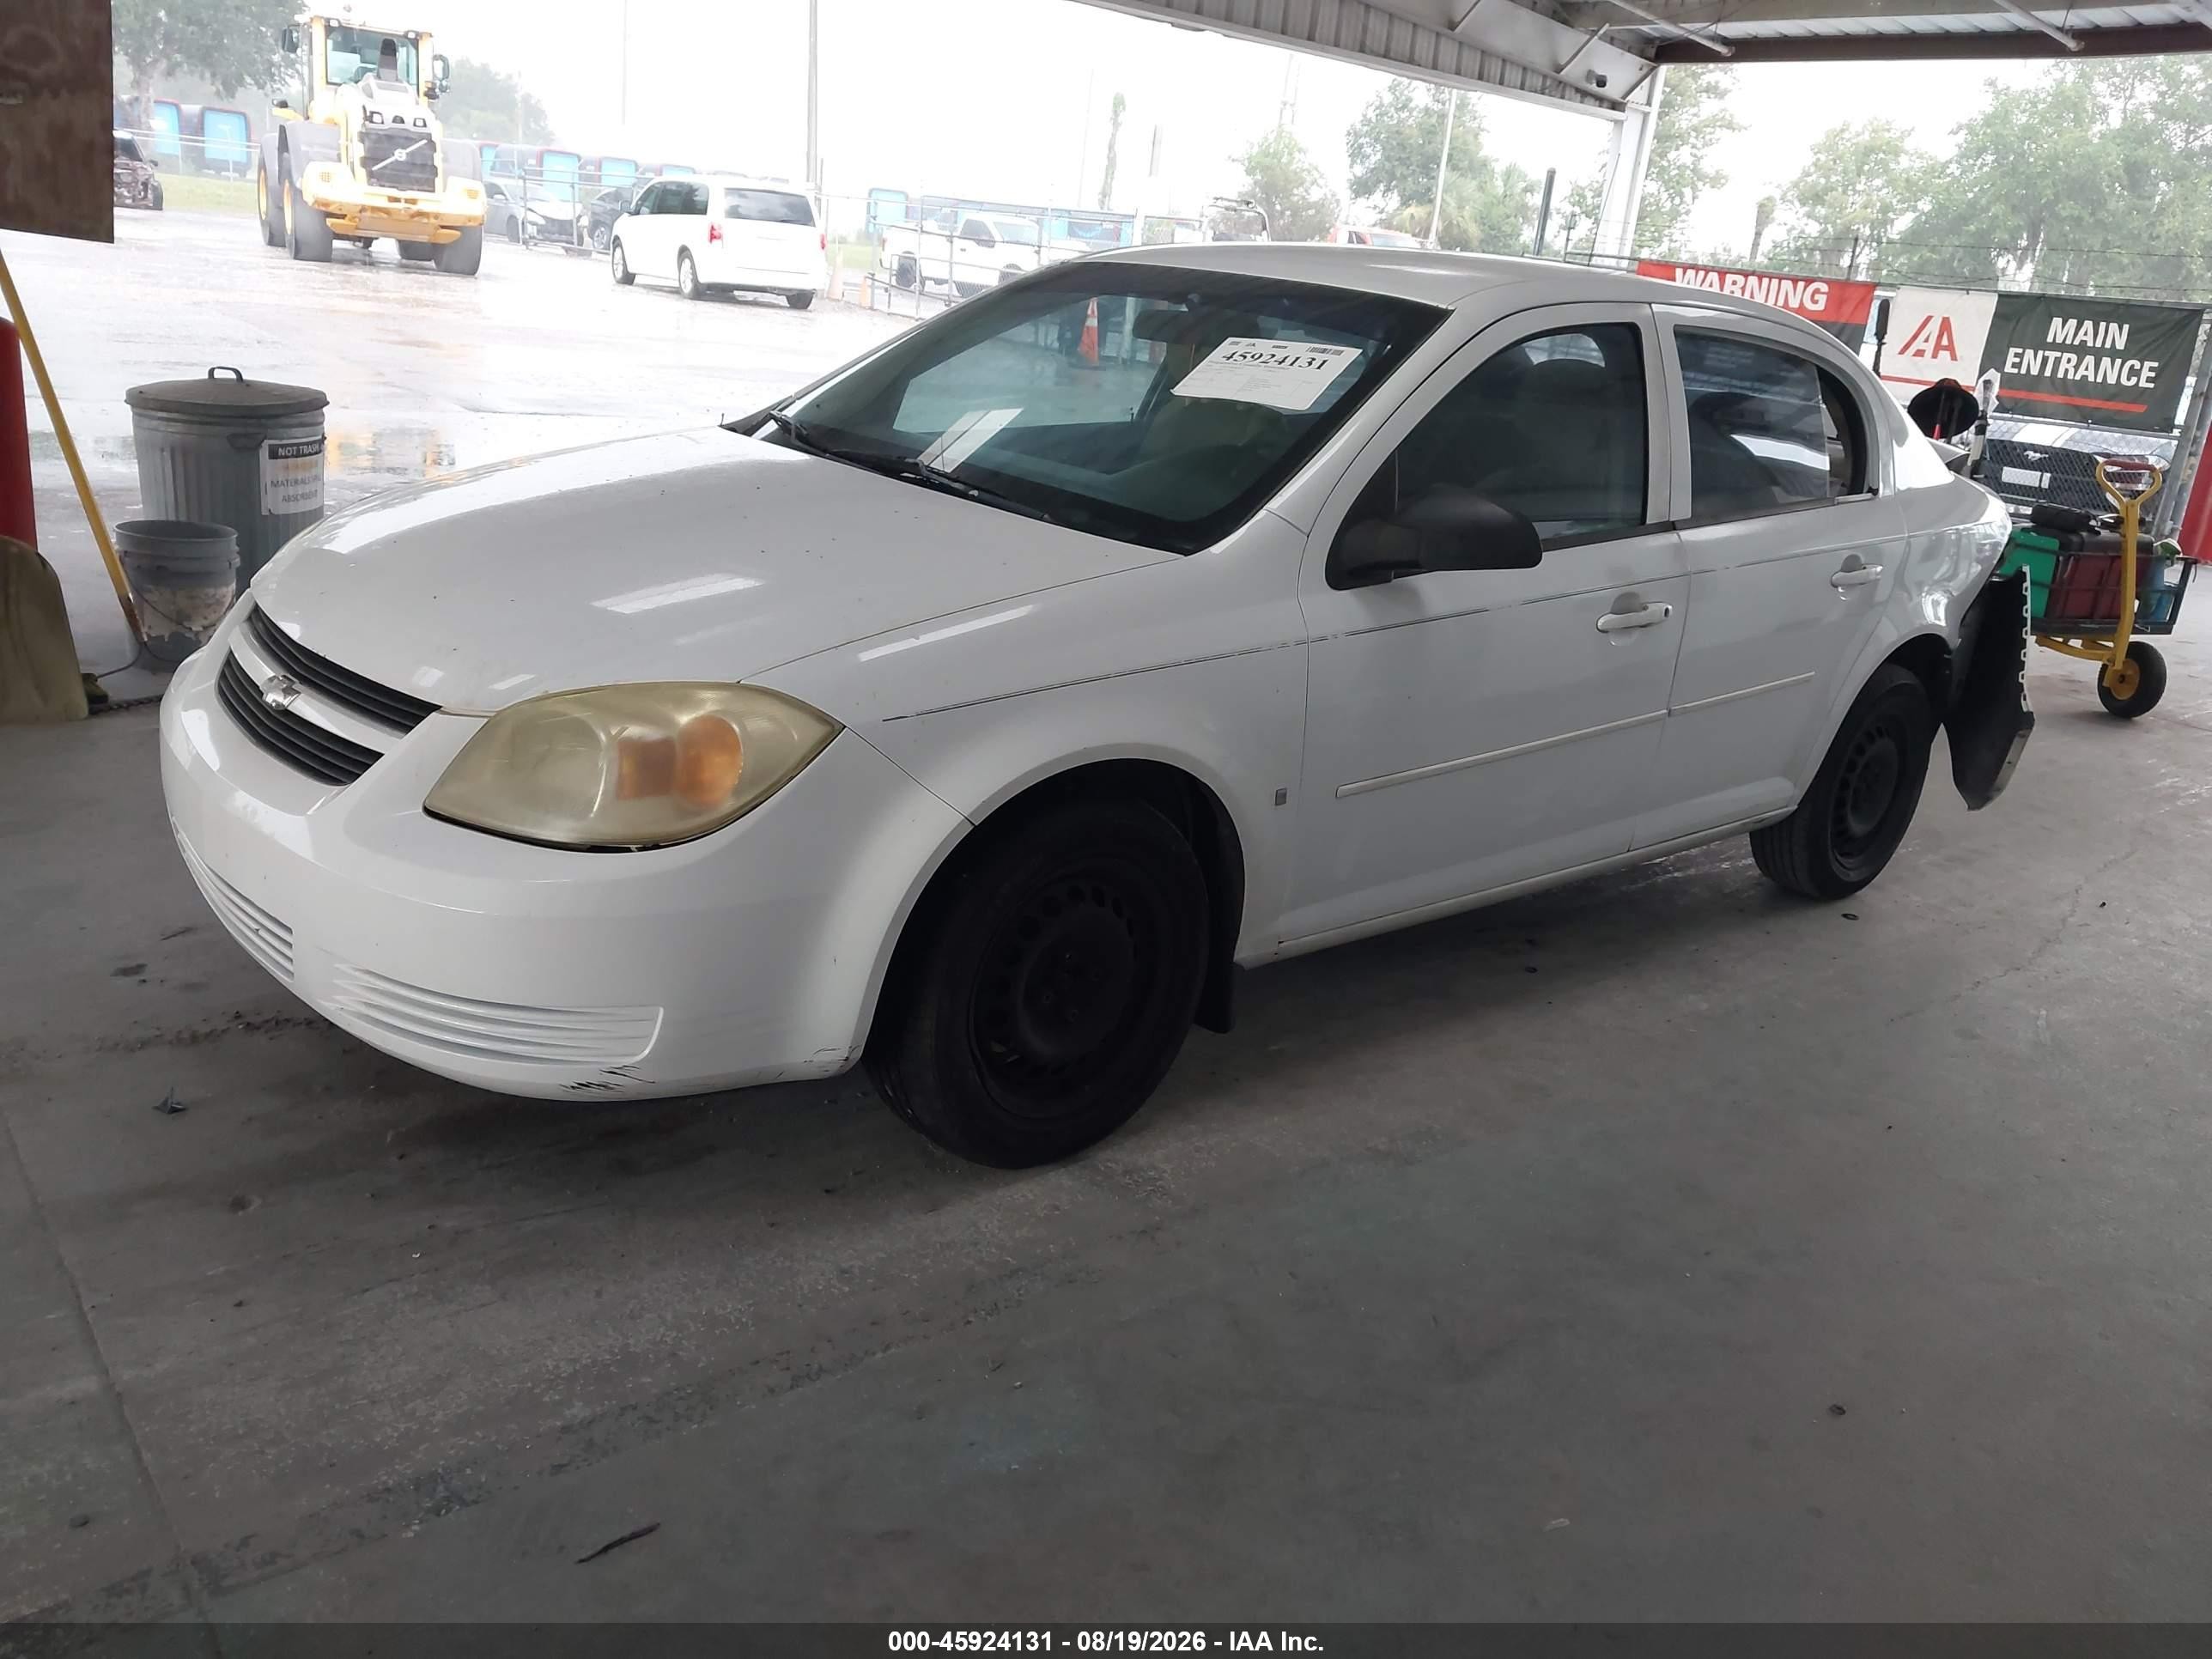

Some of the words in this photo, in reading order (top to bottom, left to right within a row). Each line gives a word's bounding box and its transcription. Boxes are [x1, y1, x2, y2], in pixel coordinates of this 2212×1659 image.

[2046, 317, 2130, 350] MAIN
[1221, 349, 1330, 371] 45924131
[2003, 348, 2160, 389] ENTRANCE
[277, 446, 298, 457] NOT
